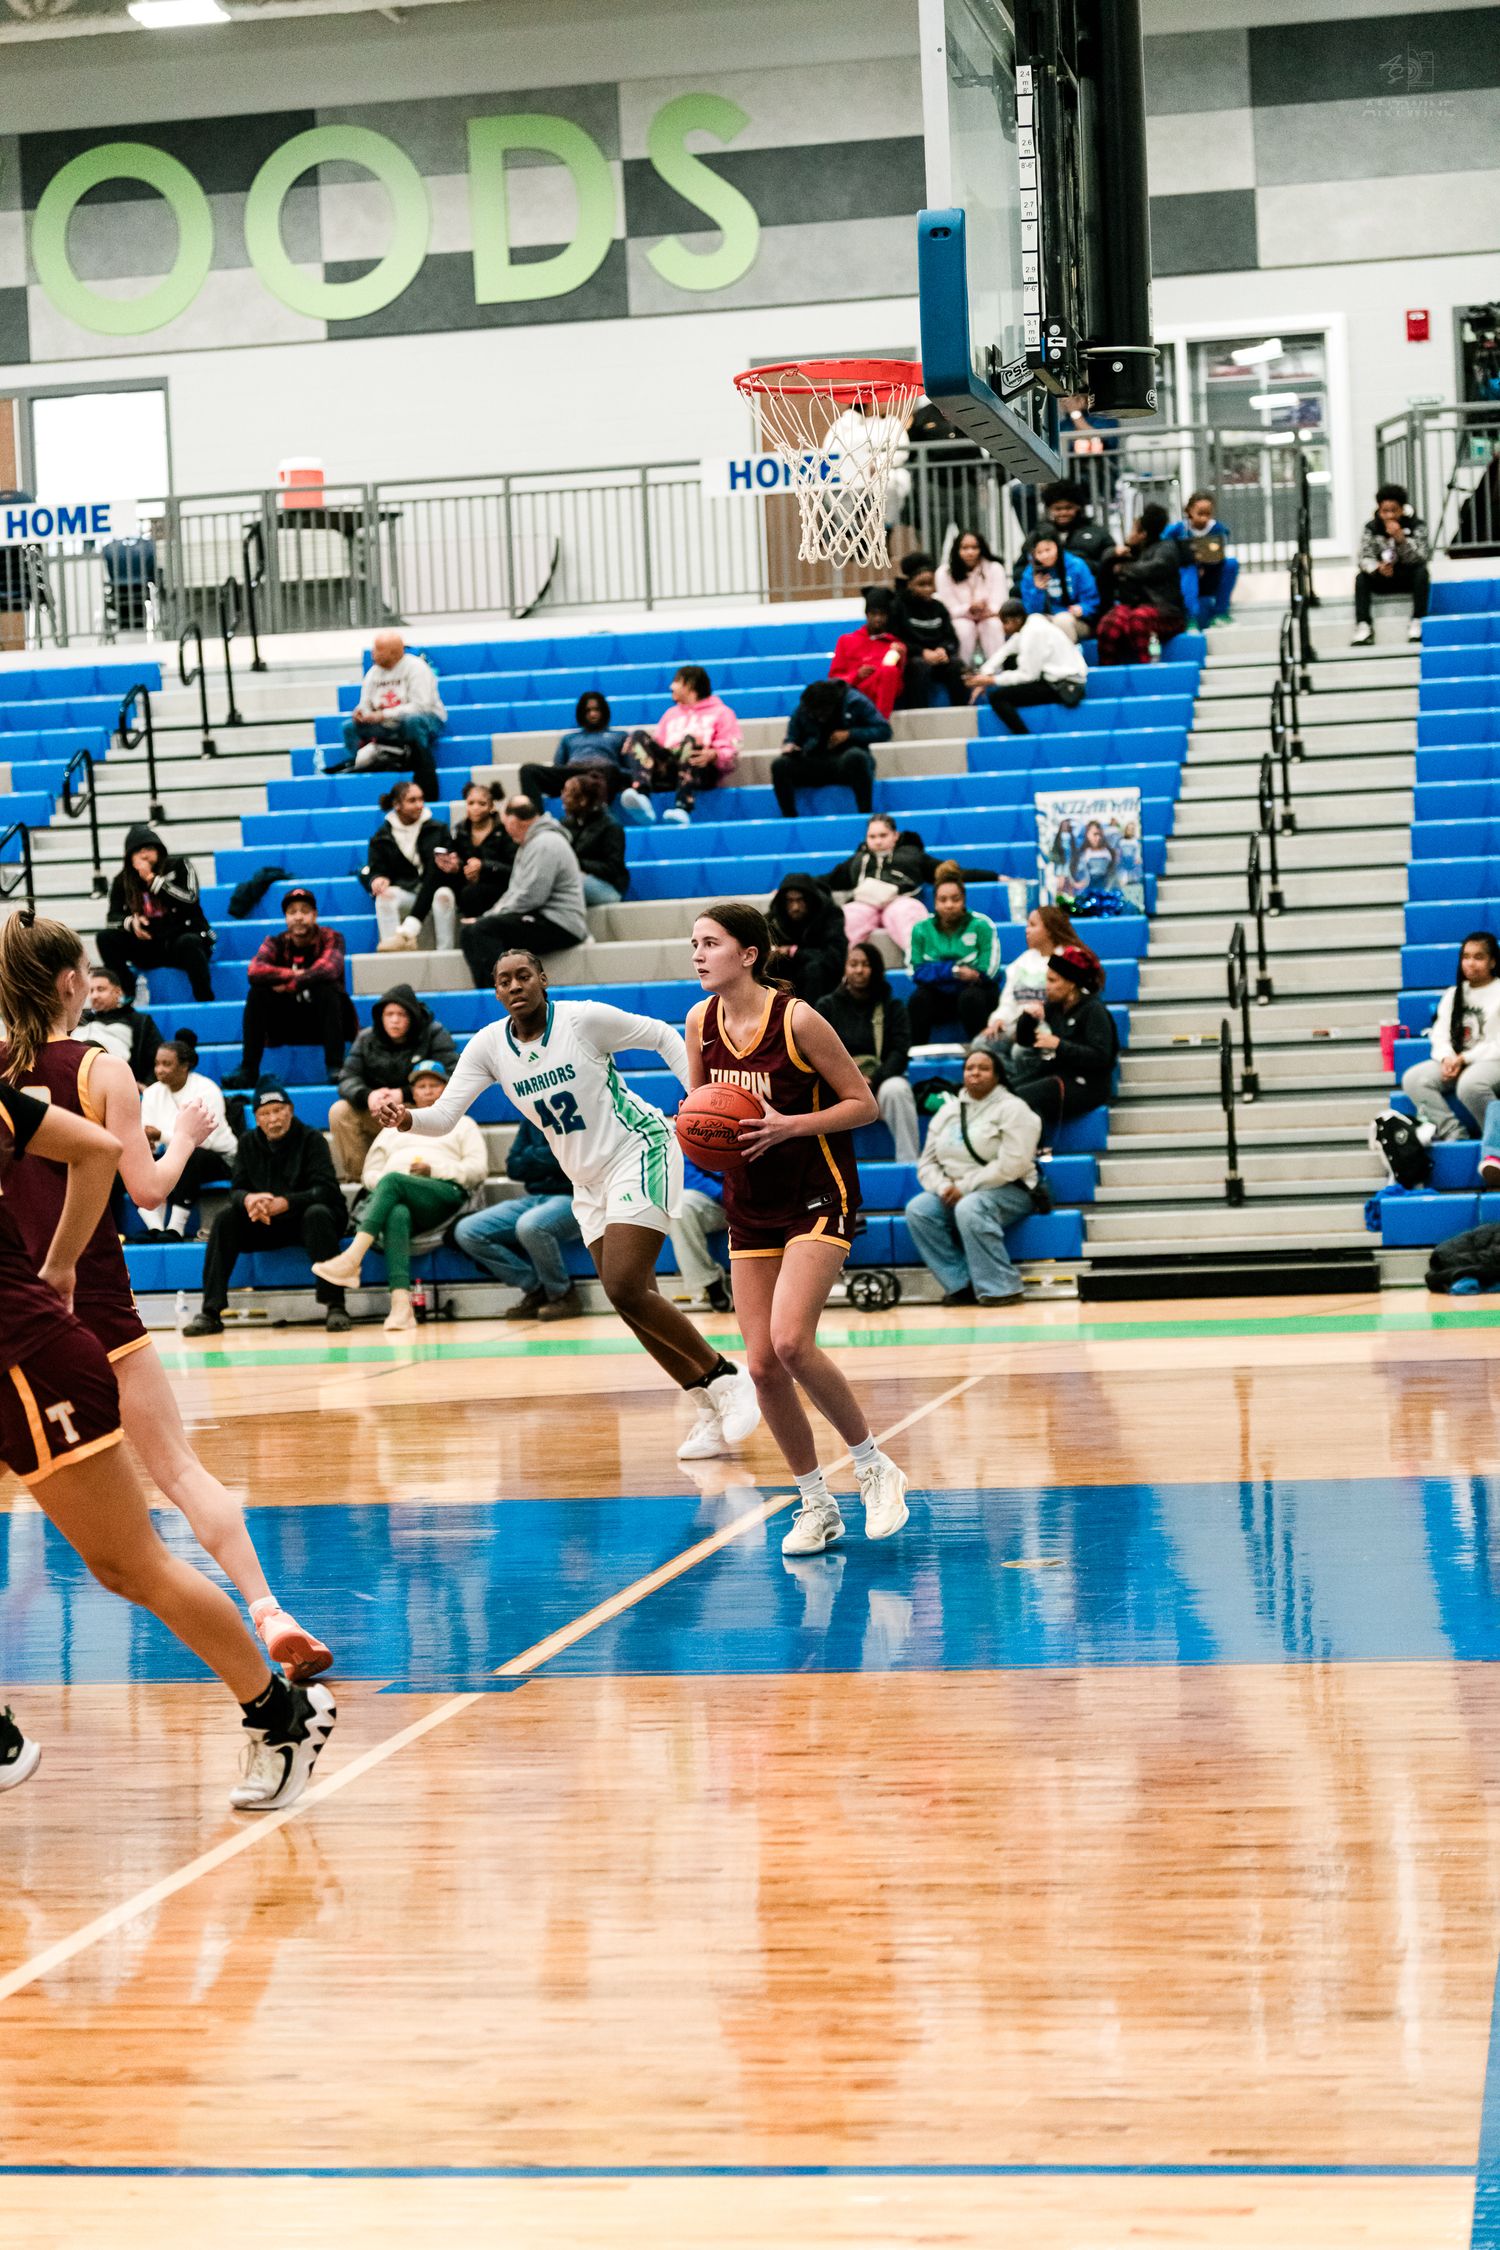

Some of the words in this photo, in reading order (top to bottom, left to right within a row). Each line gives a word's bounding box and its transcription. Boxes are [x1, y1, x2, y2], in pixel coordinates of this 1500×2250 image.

[31, 92, 760, 336] OODS
[6, 504, 112, 539] HOME
[513, 1063, 576, 1098] WARRIORS
[533, 1090, 587, 1136] 42
[45, 1400, 81, 1444] T
